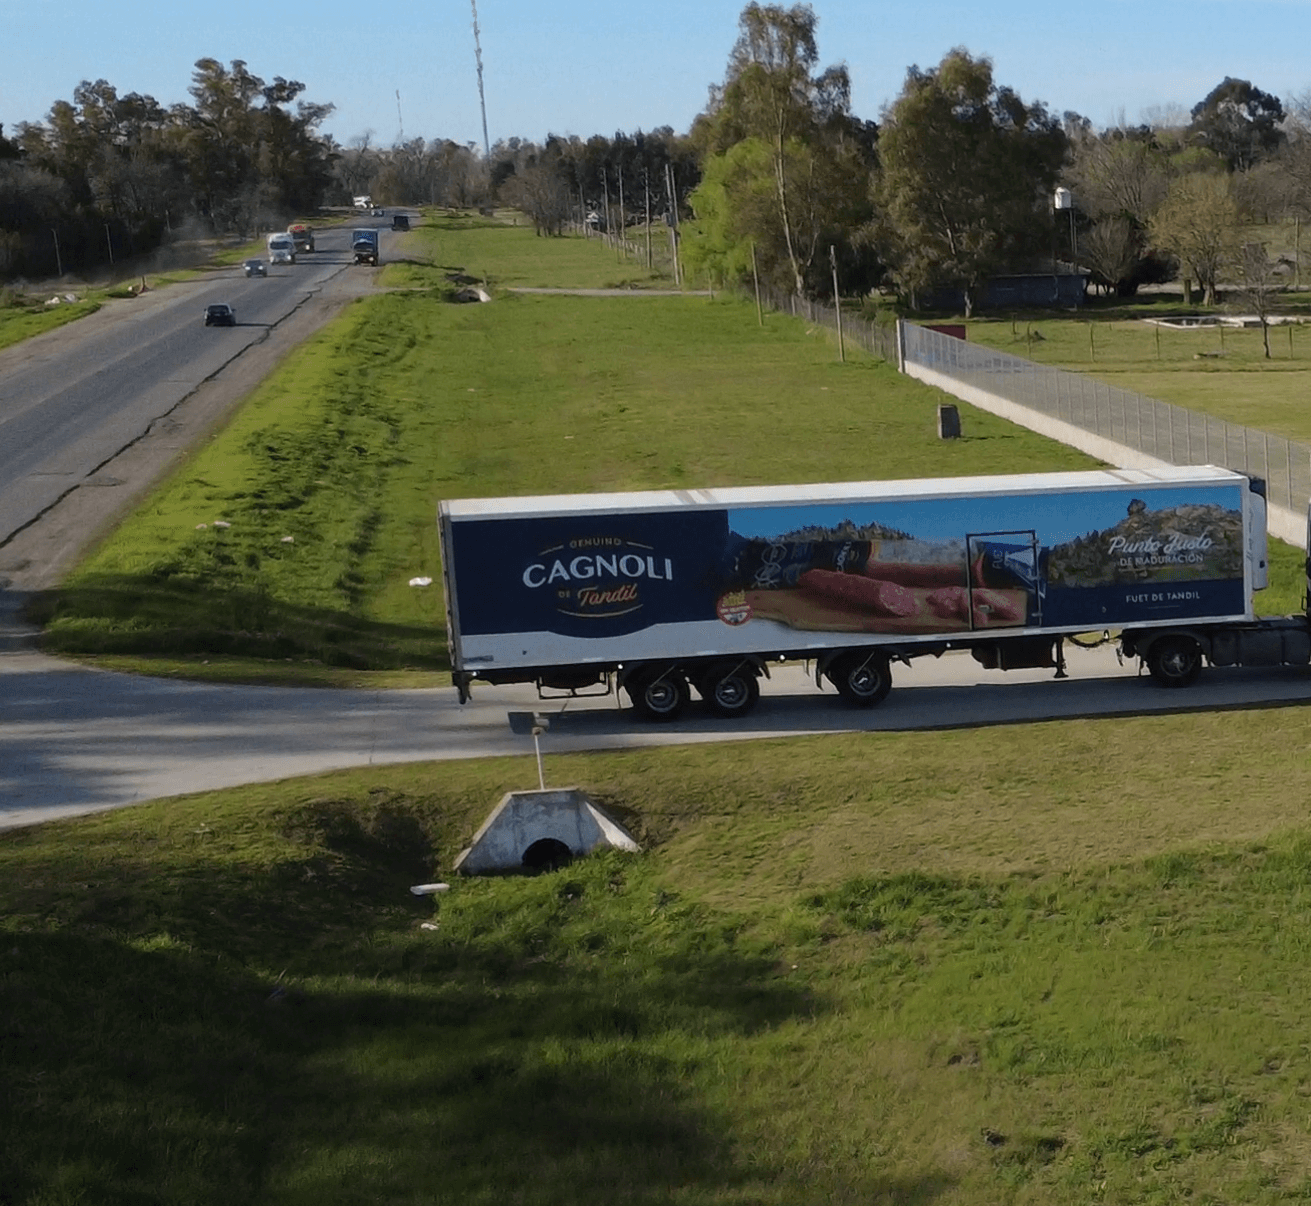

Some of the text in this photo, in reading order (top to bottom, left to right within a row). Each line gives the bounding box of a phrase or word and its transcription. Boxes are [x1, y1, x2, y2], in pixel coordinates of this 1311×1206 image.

[569, 537, 622, 549] GENUINO
[1108, 525, 1216, 555] Punto Justo
[1119, 552, 1204, 567] DE MADURACIÓN
[522, 554, 673, 588] CAGNOLI
[577, 583, 638, 607] Tandil
[1126, 591, 1201, 603] FUET DE TANDIL
